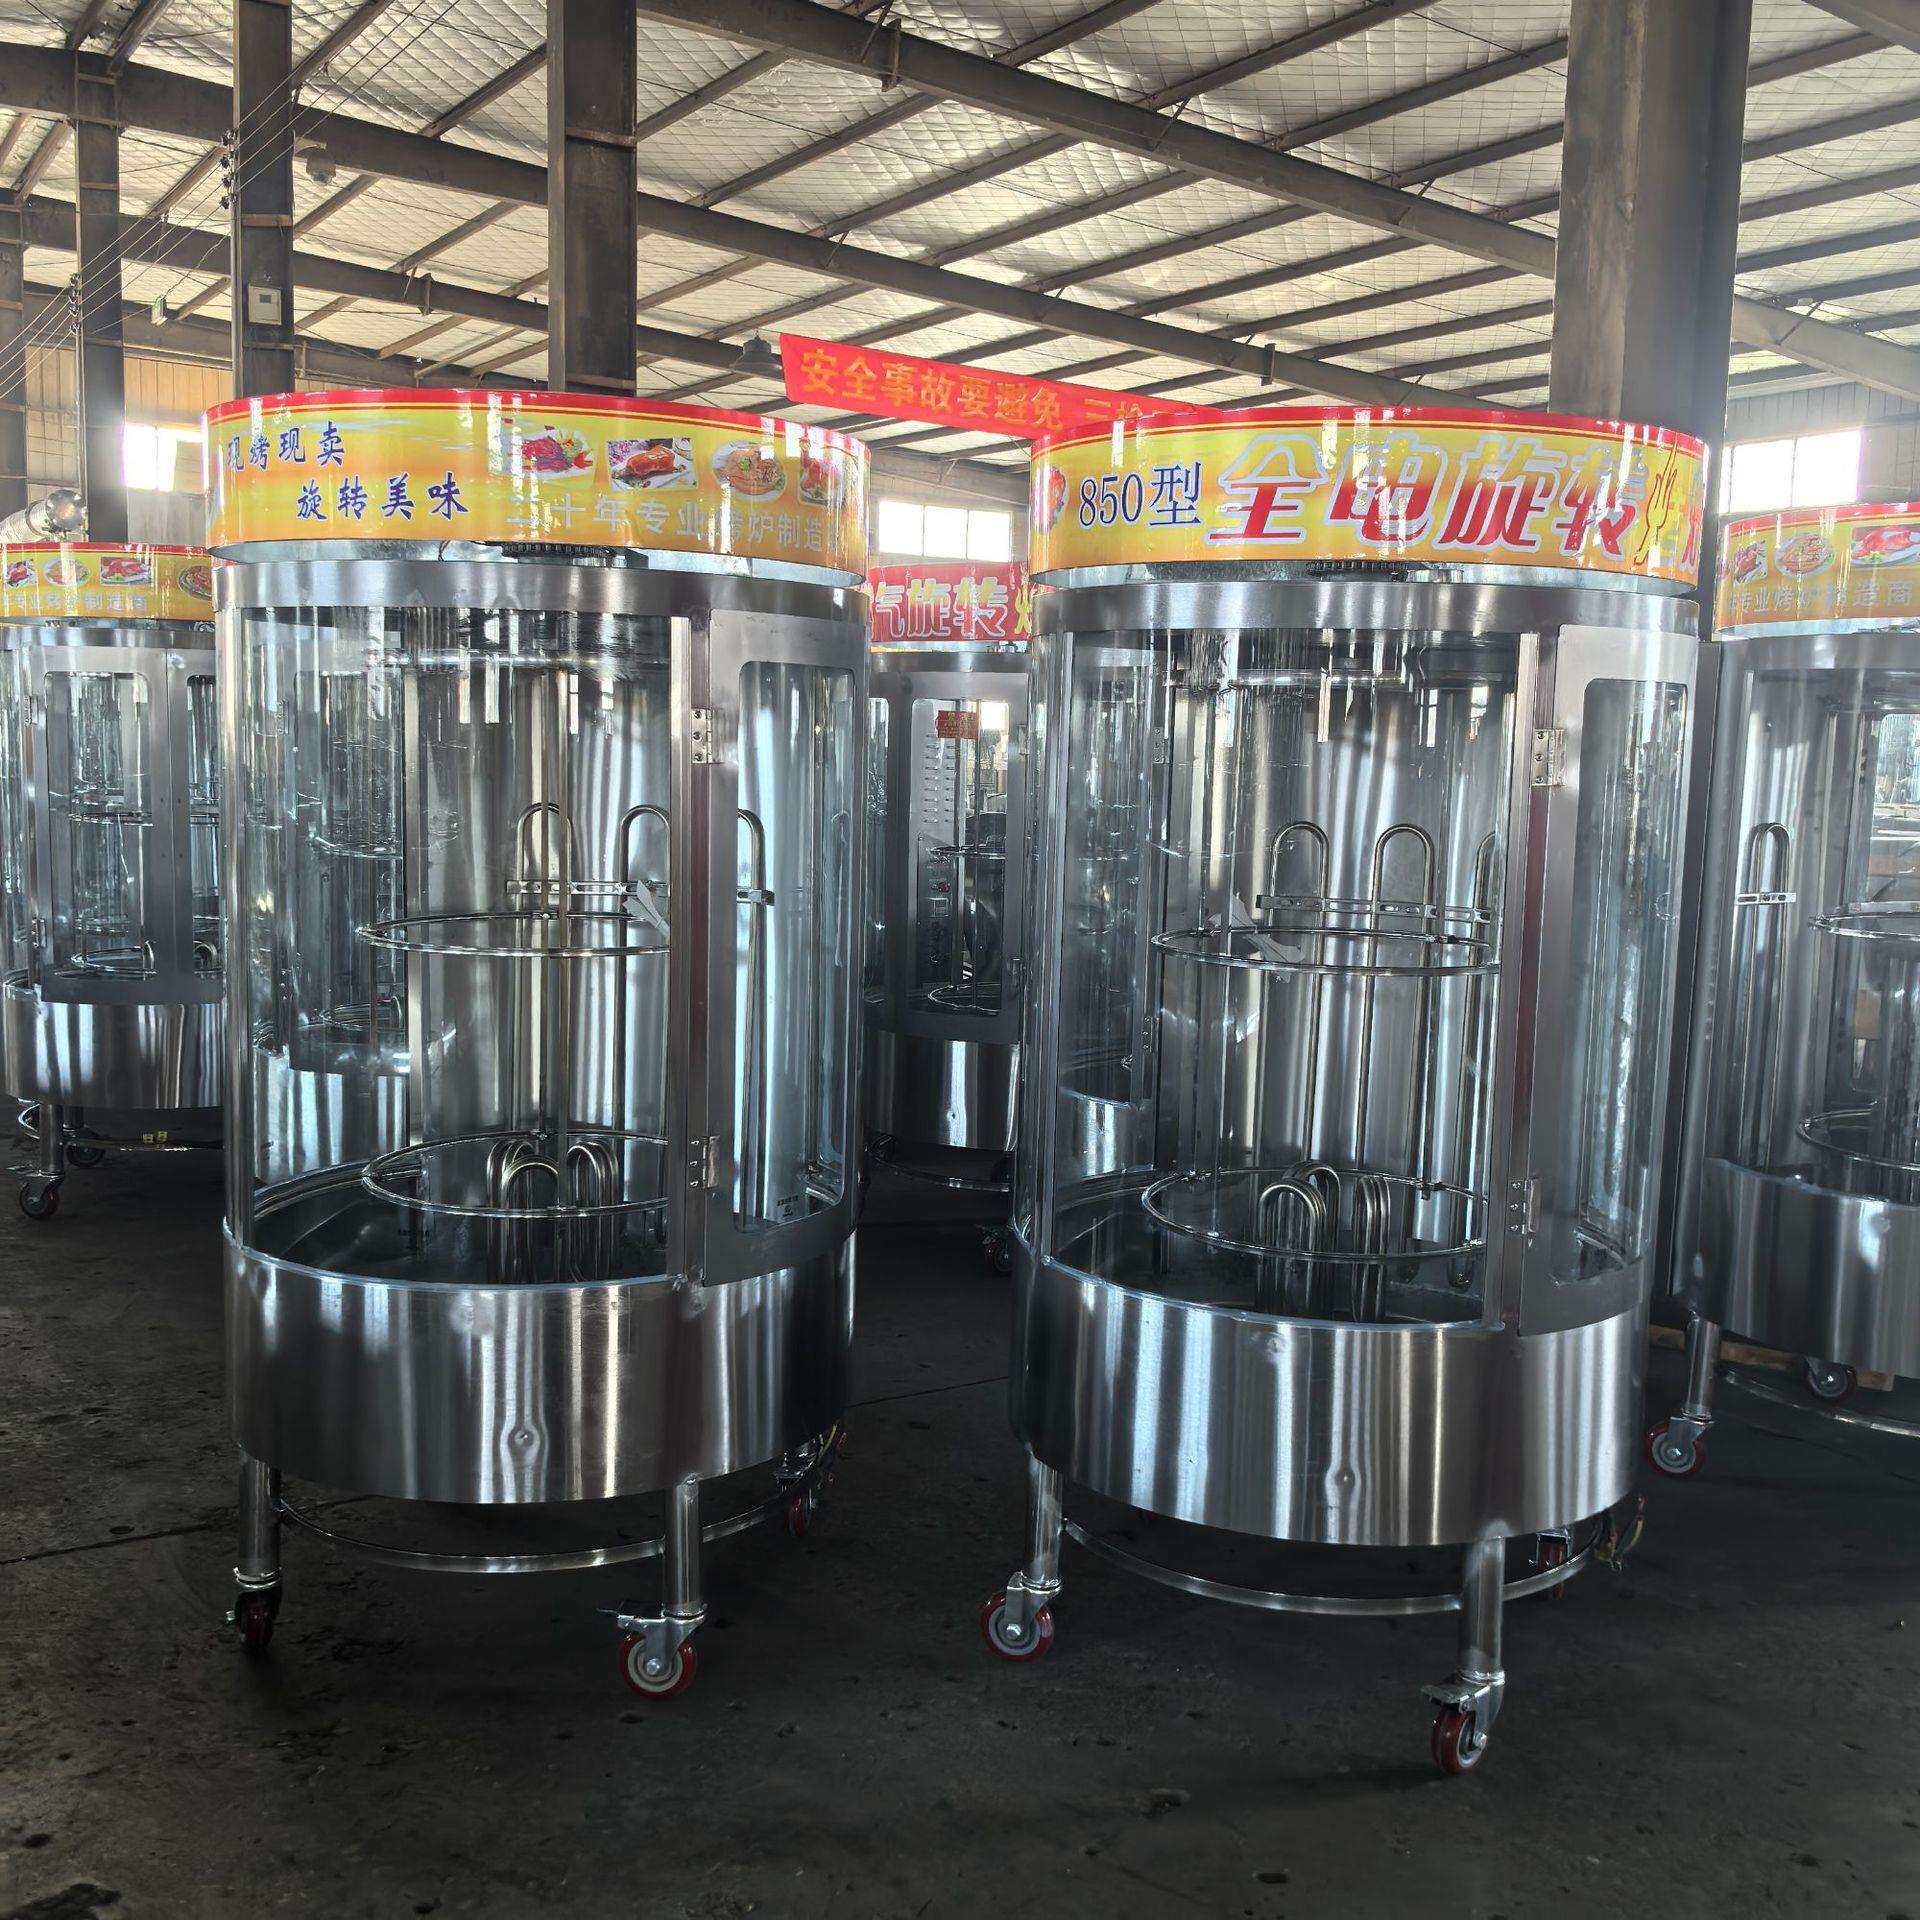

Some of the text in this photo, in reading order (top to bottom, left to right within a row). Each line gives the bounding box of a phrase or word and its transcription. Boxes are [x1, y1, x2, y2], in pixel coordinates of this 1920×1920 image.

[800, 347, 1063, 432] 安全事故要避免
[226, 420, 346, 472] 现烤现卖
[296, 471, 470, 521] 旋转美味
[1077, 459, 1203, 529] 850型
